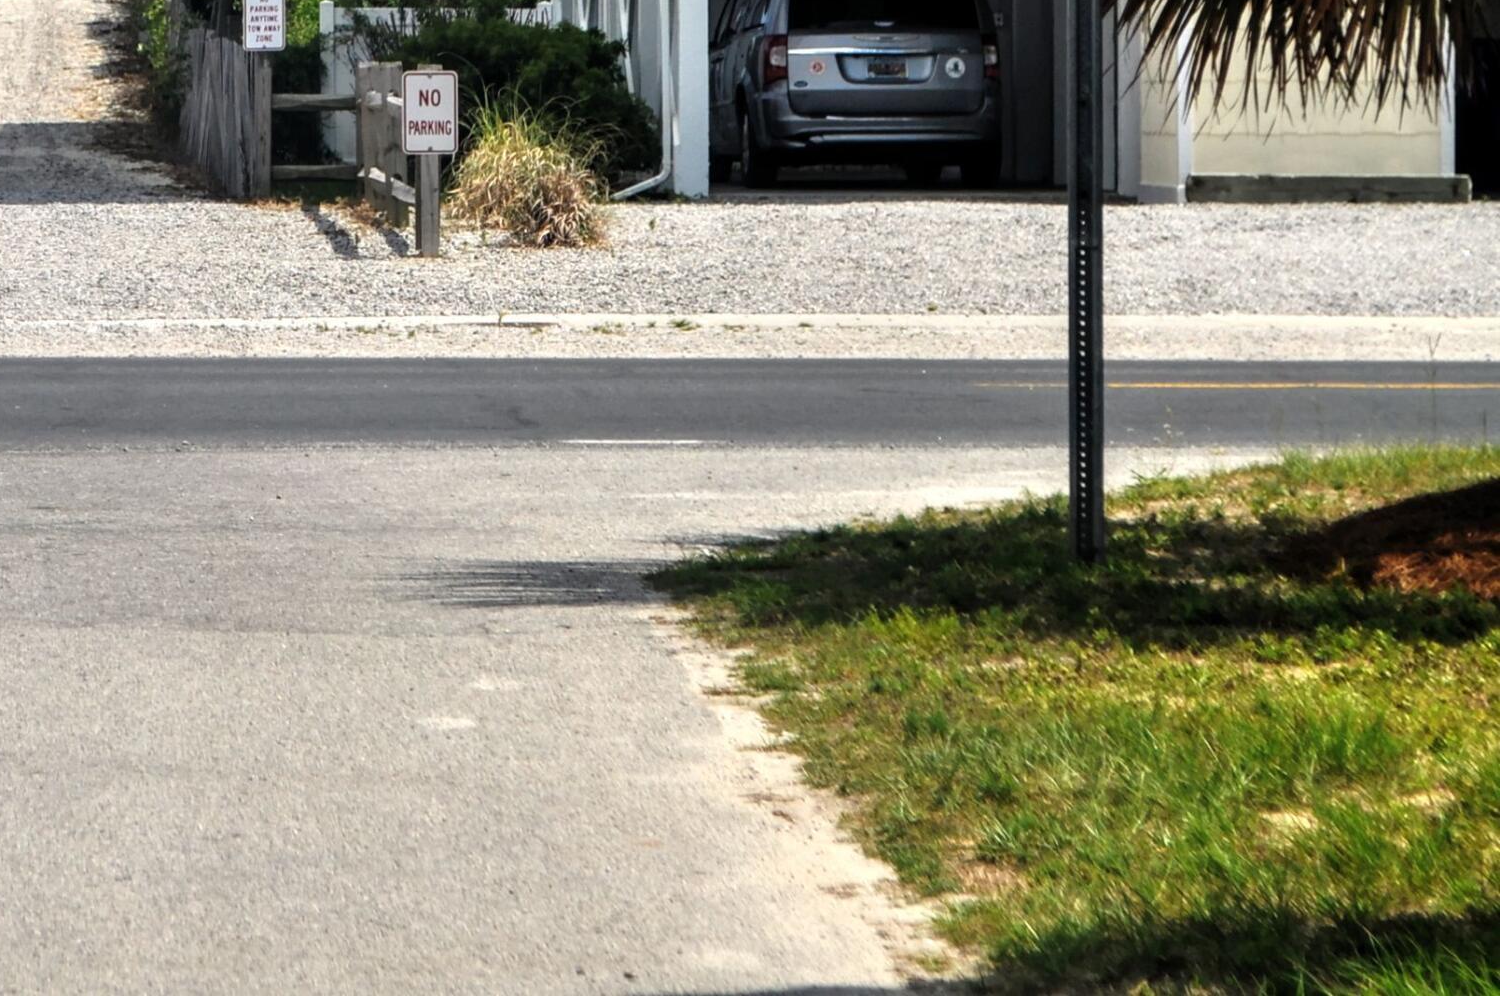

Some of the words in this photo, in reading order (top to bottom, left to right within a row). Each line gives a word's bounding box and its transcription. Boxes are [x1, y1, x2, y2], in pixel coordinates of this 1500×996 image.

[250, 5, 279, 13] PARKING
[248, 24, 261, 32] TOW
[264, 25, 281, 33] AWAY
[256, 34, 273, 43] ZONE
[419, 89, 442, 107] NO
[408, 120, 452, 136] PARKING
